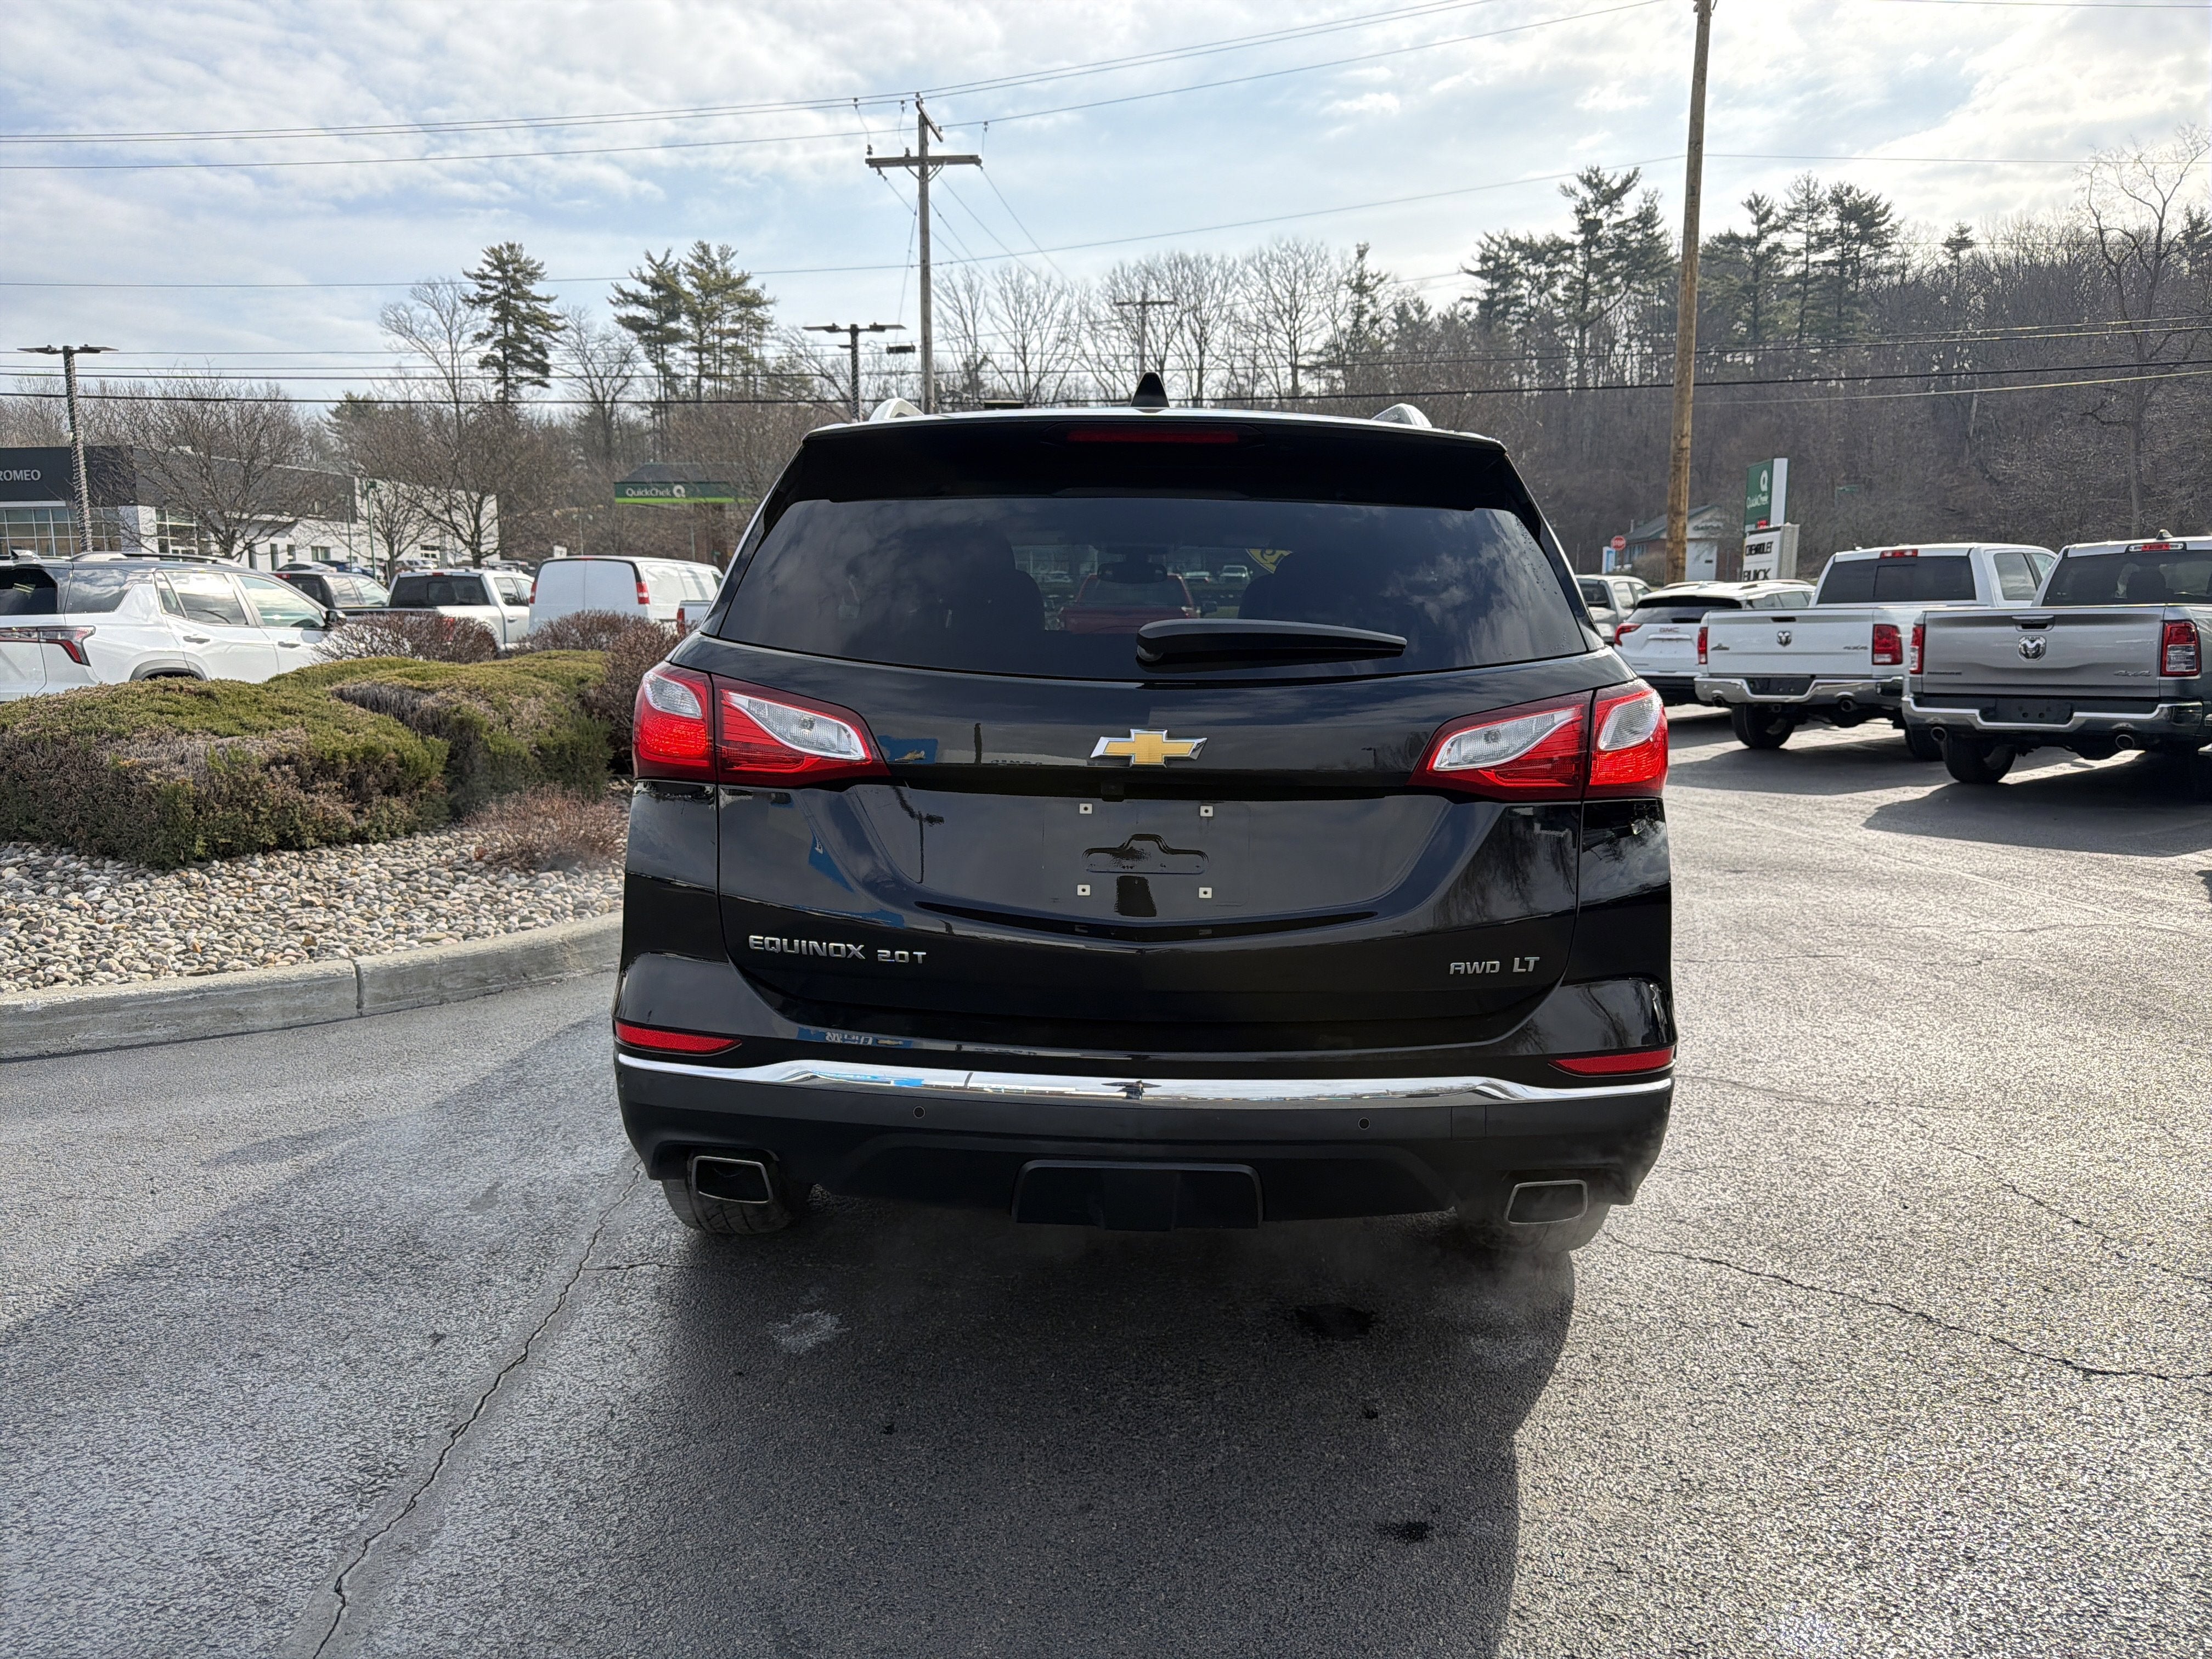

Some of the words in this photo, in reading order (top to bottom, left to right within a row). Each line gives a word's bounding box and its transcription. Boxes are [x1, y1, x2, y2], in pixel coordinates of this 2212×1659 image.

[0, 469, 41, 481] ROMEO
[625, 487, 672, 498] QuickChek
[1743, 568, 1771, 582] BUICK
[748, 935, 866, 960] EQUINOX
[1449, 961, 1500, 975] AWD
[1513, 957, 1540, 973] LT
